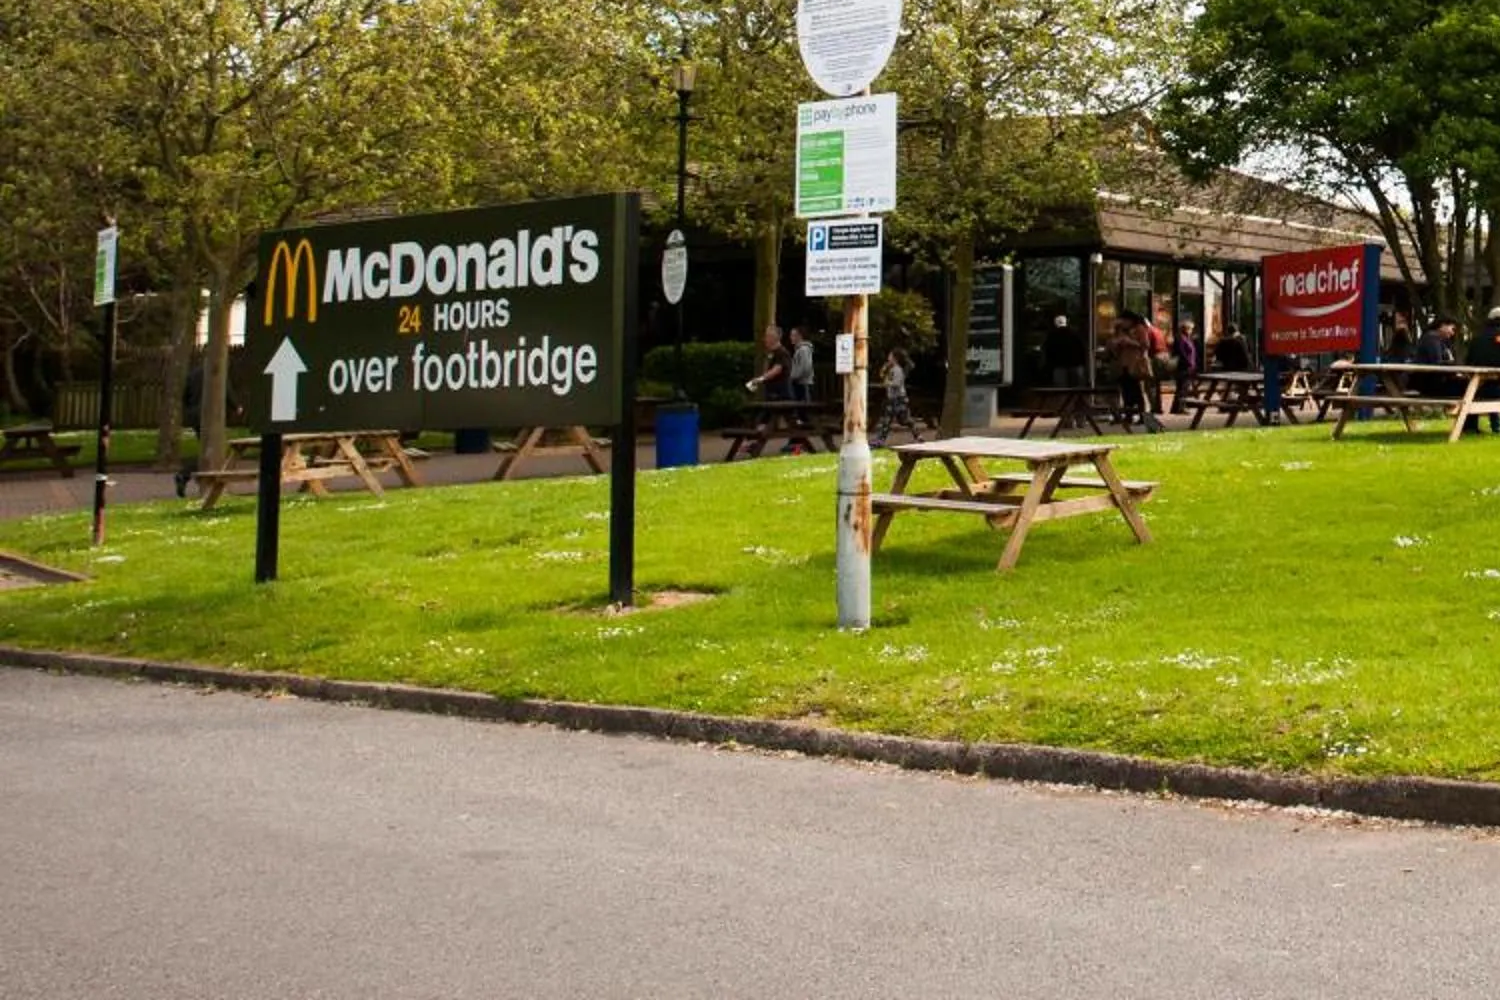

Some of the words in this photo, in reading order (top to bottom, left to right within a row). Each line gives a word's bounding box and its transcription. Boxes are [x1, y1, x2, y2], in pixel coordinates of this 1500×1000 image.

[812, 227, 825, 250] P
[322, 225, 600, 303] McDonald's
[1279, 258, 1360, 297] roadchef
[398, 305, 423, 334] 24
[433, 298, 511, 332] HOURS
[328, 355, 400, 396] over
[412, 336, 598, 397] footbridge
